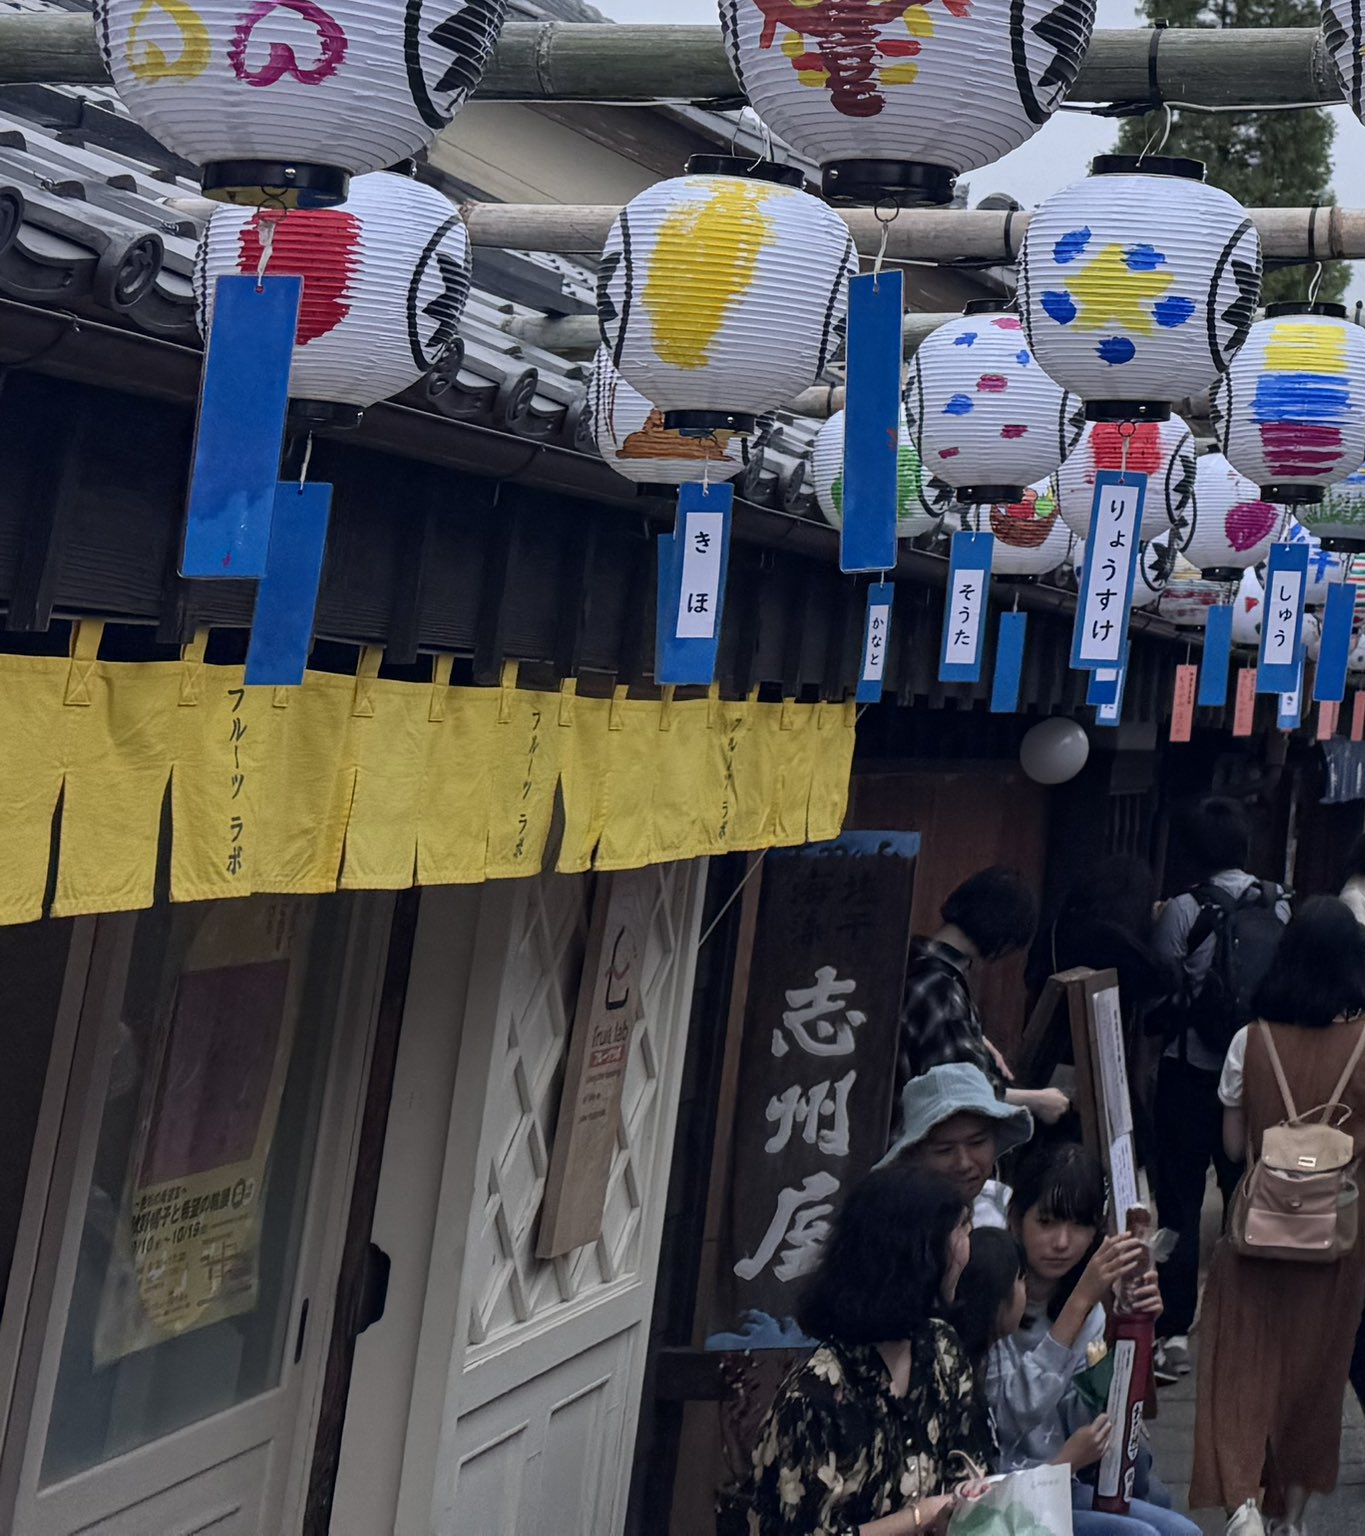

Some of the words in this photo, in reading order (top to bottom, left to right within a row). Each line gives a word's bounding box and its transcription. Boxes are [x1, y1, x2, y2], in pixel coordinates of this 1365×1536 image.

[687, 531, 711, 613] きほ
[1090, 498, 1125, 641] りょうすけ
[870, 617, 884, 666] かなと
[953, 584, 976, 646] そうた
[1274, 585, 1293, 646] しゅう
[228, 688, 248, 800] フルーツ
[522, 711, 541, 800] フルーツ
[225, 815, 244, 876] ラボ
[732, 965, 869, 1282] 志州屋
